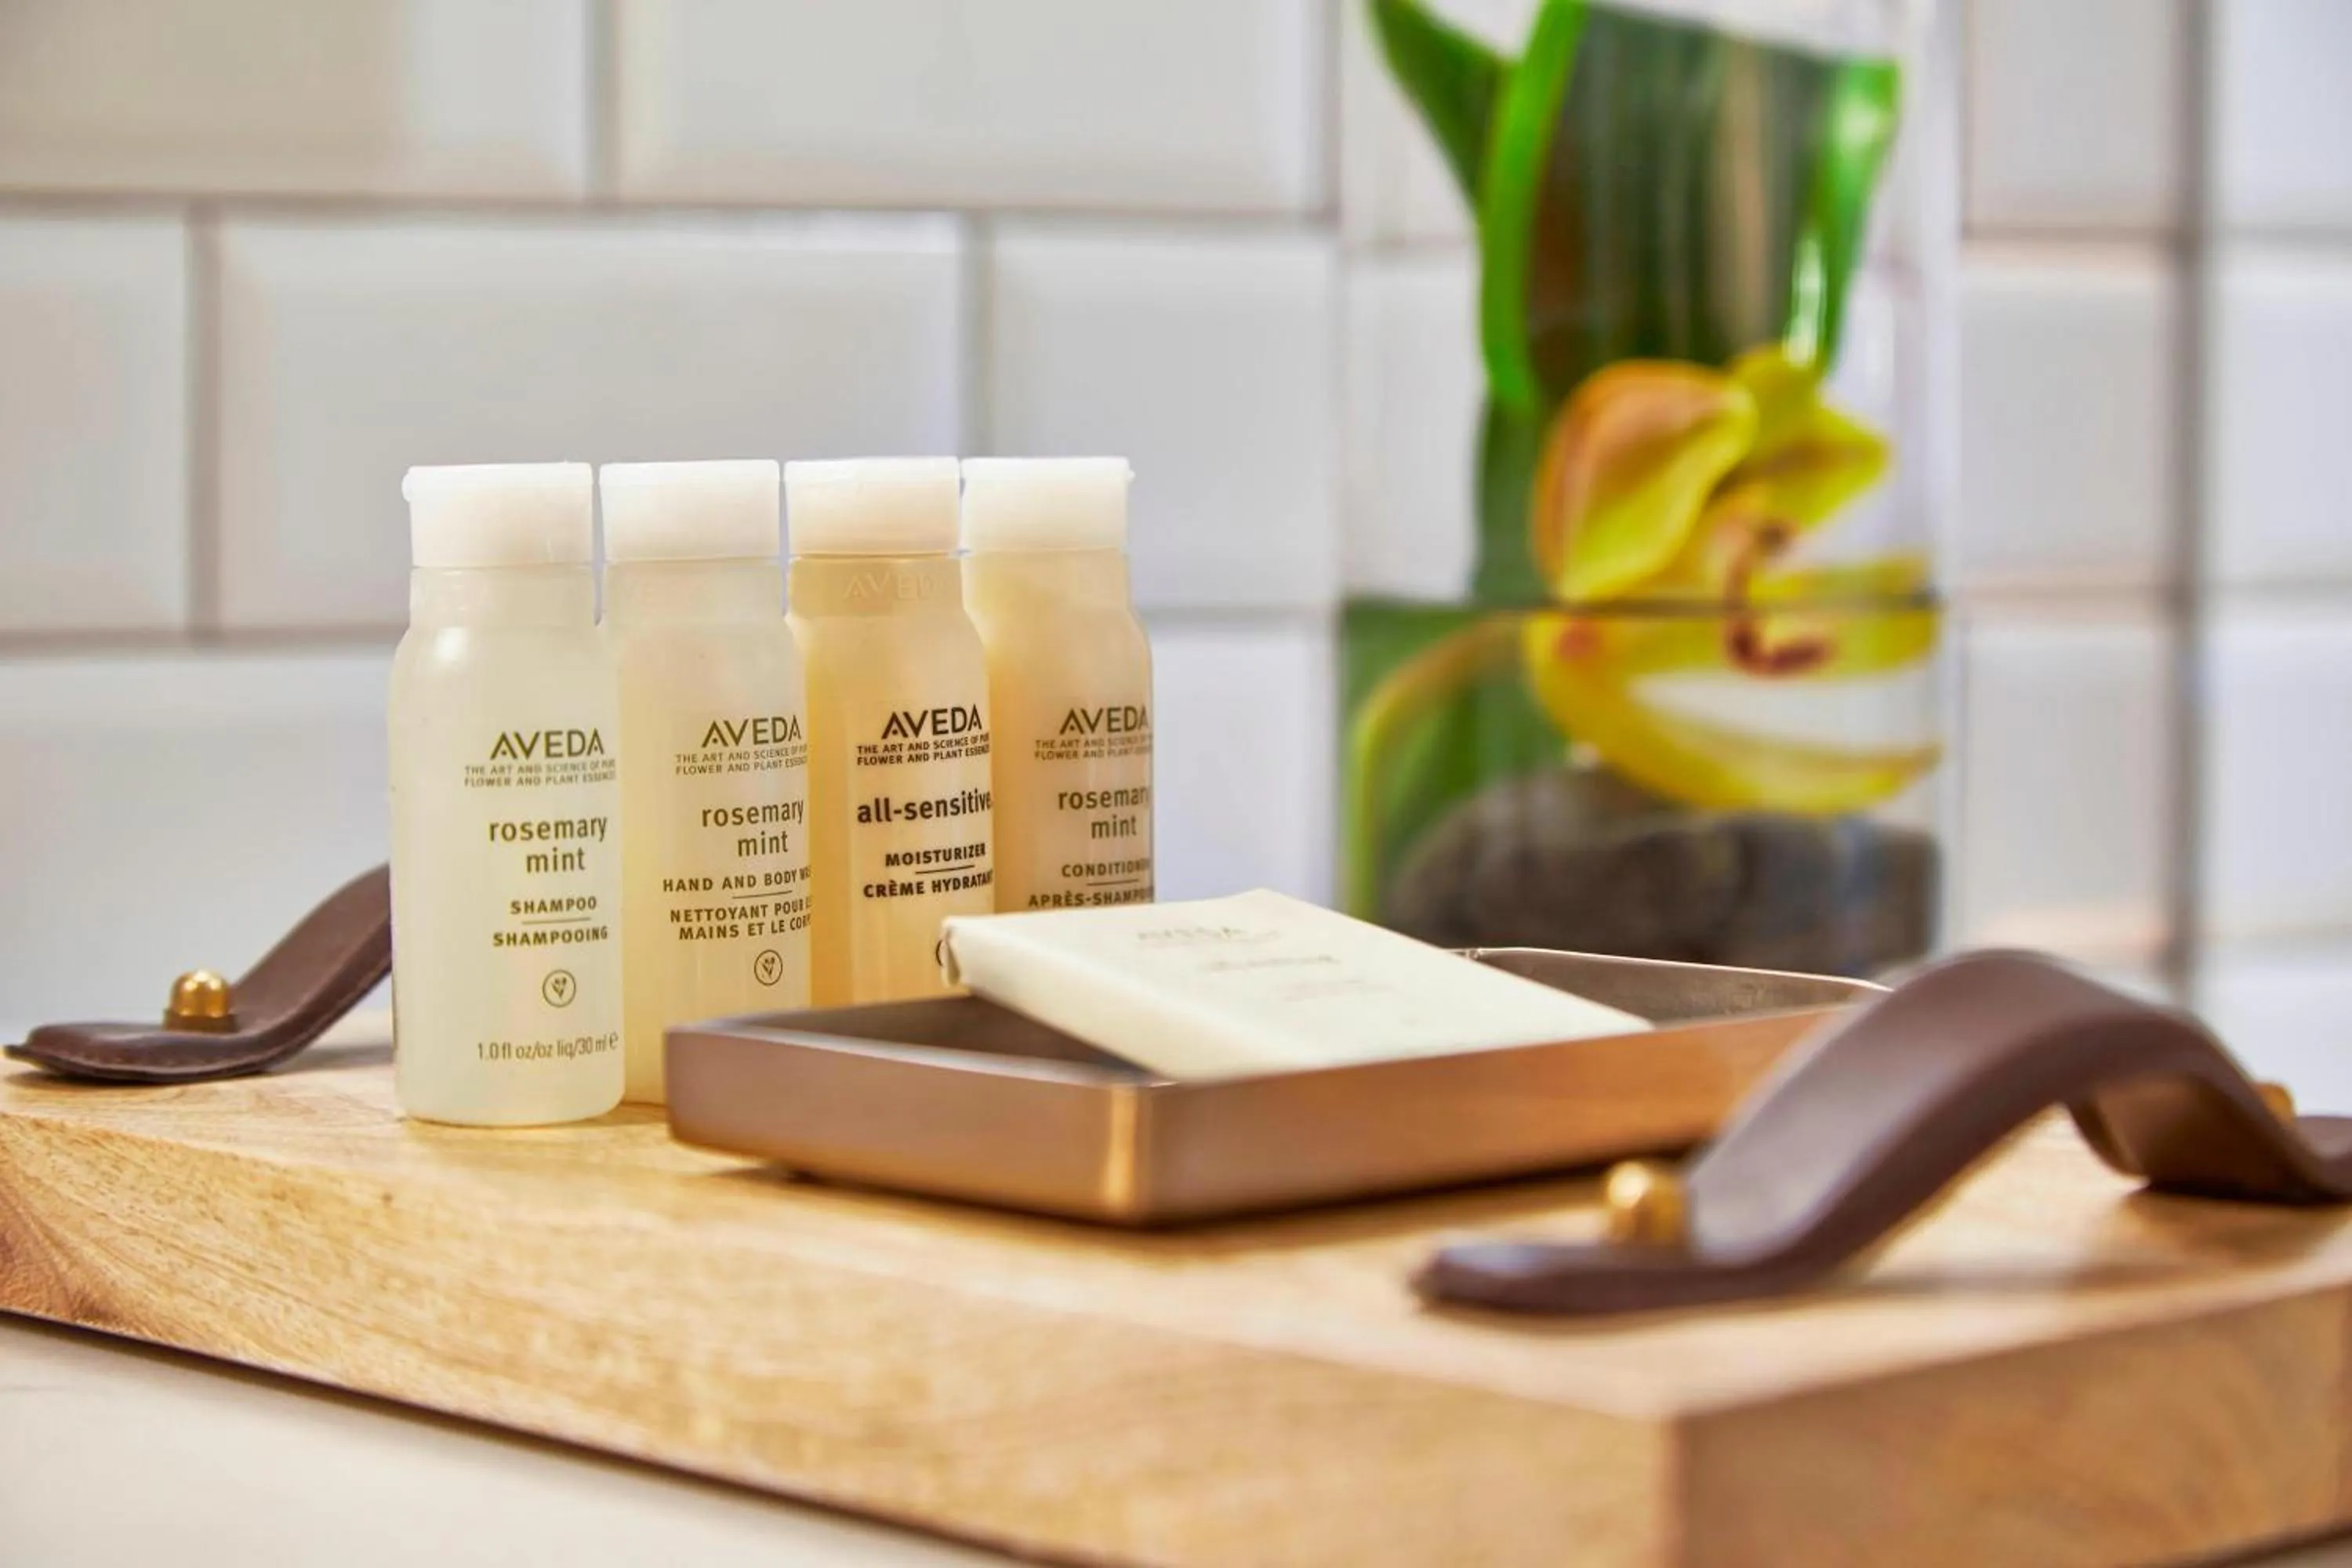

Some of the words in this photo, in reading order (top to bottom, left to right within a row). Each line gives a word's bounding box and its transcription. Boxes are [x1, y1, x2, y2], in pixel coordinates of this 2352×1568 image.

[881, 704, 982, 739] AVEDA
[1059, 703, 1149, 735] AVEDA
[701, 715, 802, 748] AVEDA
[490, 728, 604, 760] AVEDA
[675, 753, 697, 763] THE
[702, 753, 723, 762] ART
[728, 751, 750, 761] AND
[753, 748, 789, 760] SCIENCE
[857, 746, 878, 754] THE
[883, 743, 903, 753] ART
[907, 741, 929, 752] AND
[933, 736, 968, 750] SCIENCE
[465, 765, 485, 775] THE
[490, 764, 512, 774] ART
[517, 764, 542, 774] AND
[546, 761, 586, 772] SCIENCE
[675, 765, 722, 775] FLOWER
[728, 764, 750, 773] AND
[754, 760, 782, 771] PLANT
[857, 755, 902, 766] FLOWER
[907, 753, 929, 763] AND
[934, 749, 963, 760] PLANT
[465, 776, 510, 787] FLOWER
[516, 775, 541, 786] AND
[546, 774, 579, 786] PLANT
[702, 800, 804, 827] rosemary
[489, 816, 608, 843] rosemary
[1091, 815, 1137, 839] mint
[738, 831, 788, 857] mint
[885, 843, 986, 867] MOISTURIZER
[526, 846, 586, 873] mint
[662, 877, 713, 892] HAND
[721, 875, 757, 890] AND
[764, 869, 797, 886] BODY
[863, 879, 925, 898] CRÈME
[510, 895, 597, 915] SHAMPOO
[670, 904, 768, 923] NETTOYANT
[492, 926, 608, 947] SHAMPOOING
[679, 924, 739, 940] MAINS
[747, 922, 765, 937] ET
[771, 920, 785, 935] LE
[515, 1040, 553, 1060] oz/oz
[557, 1036, 593, 1061] liq/30
